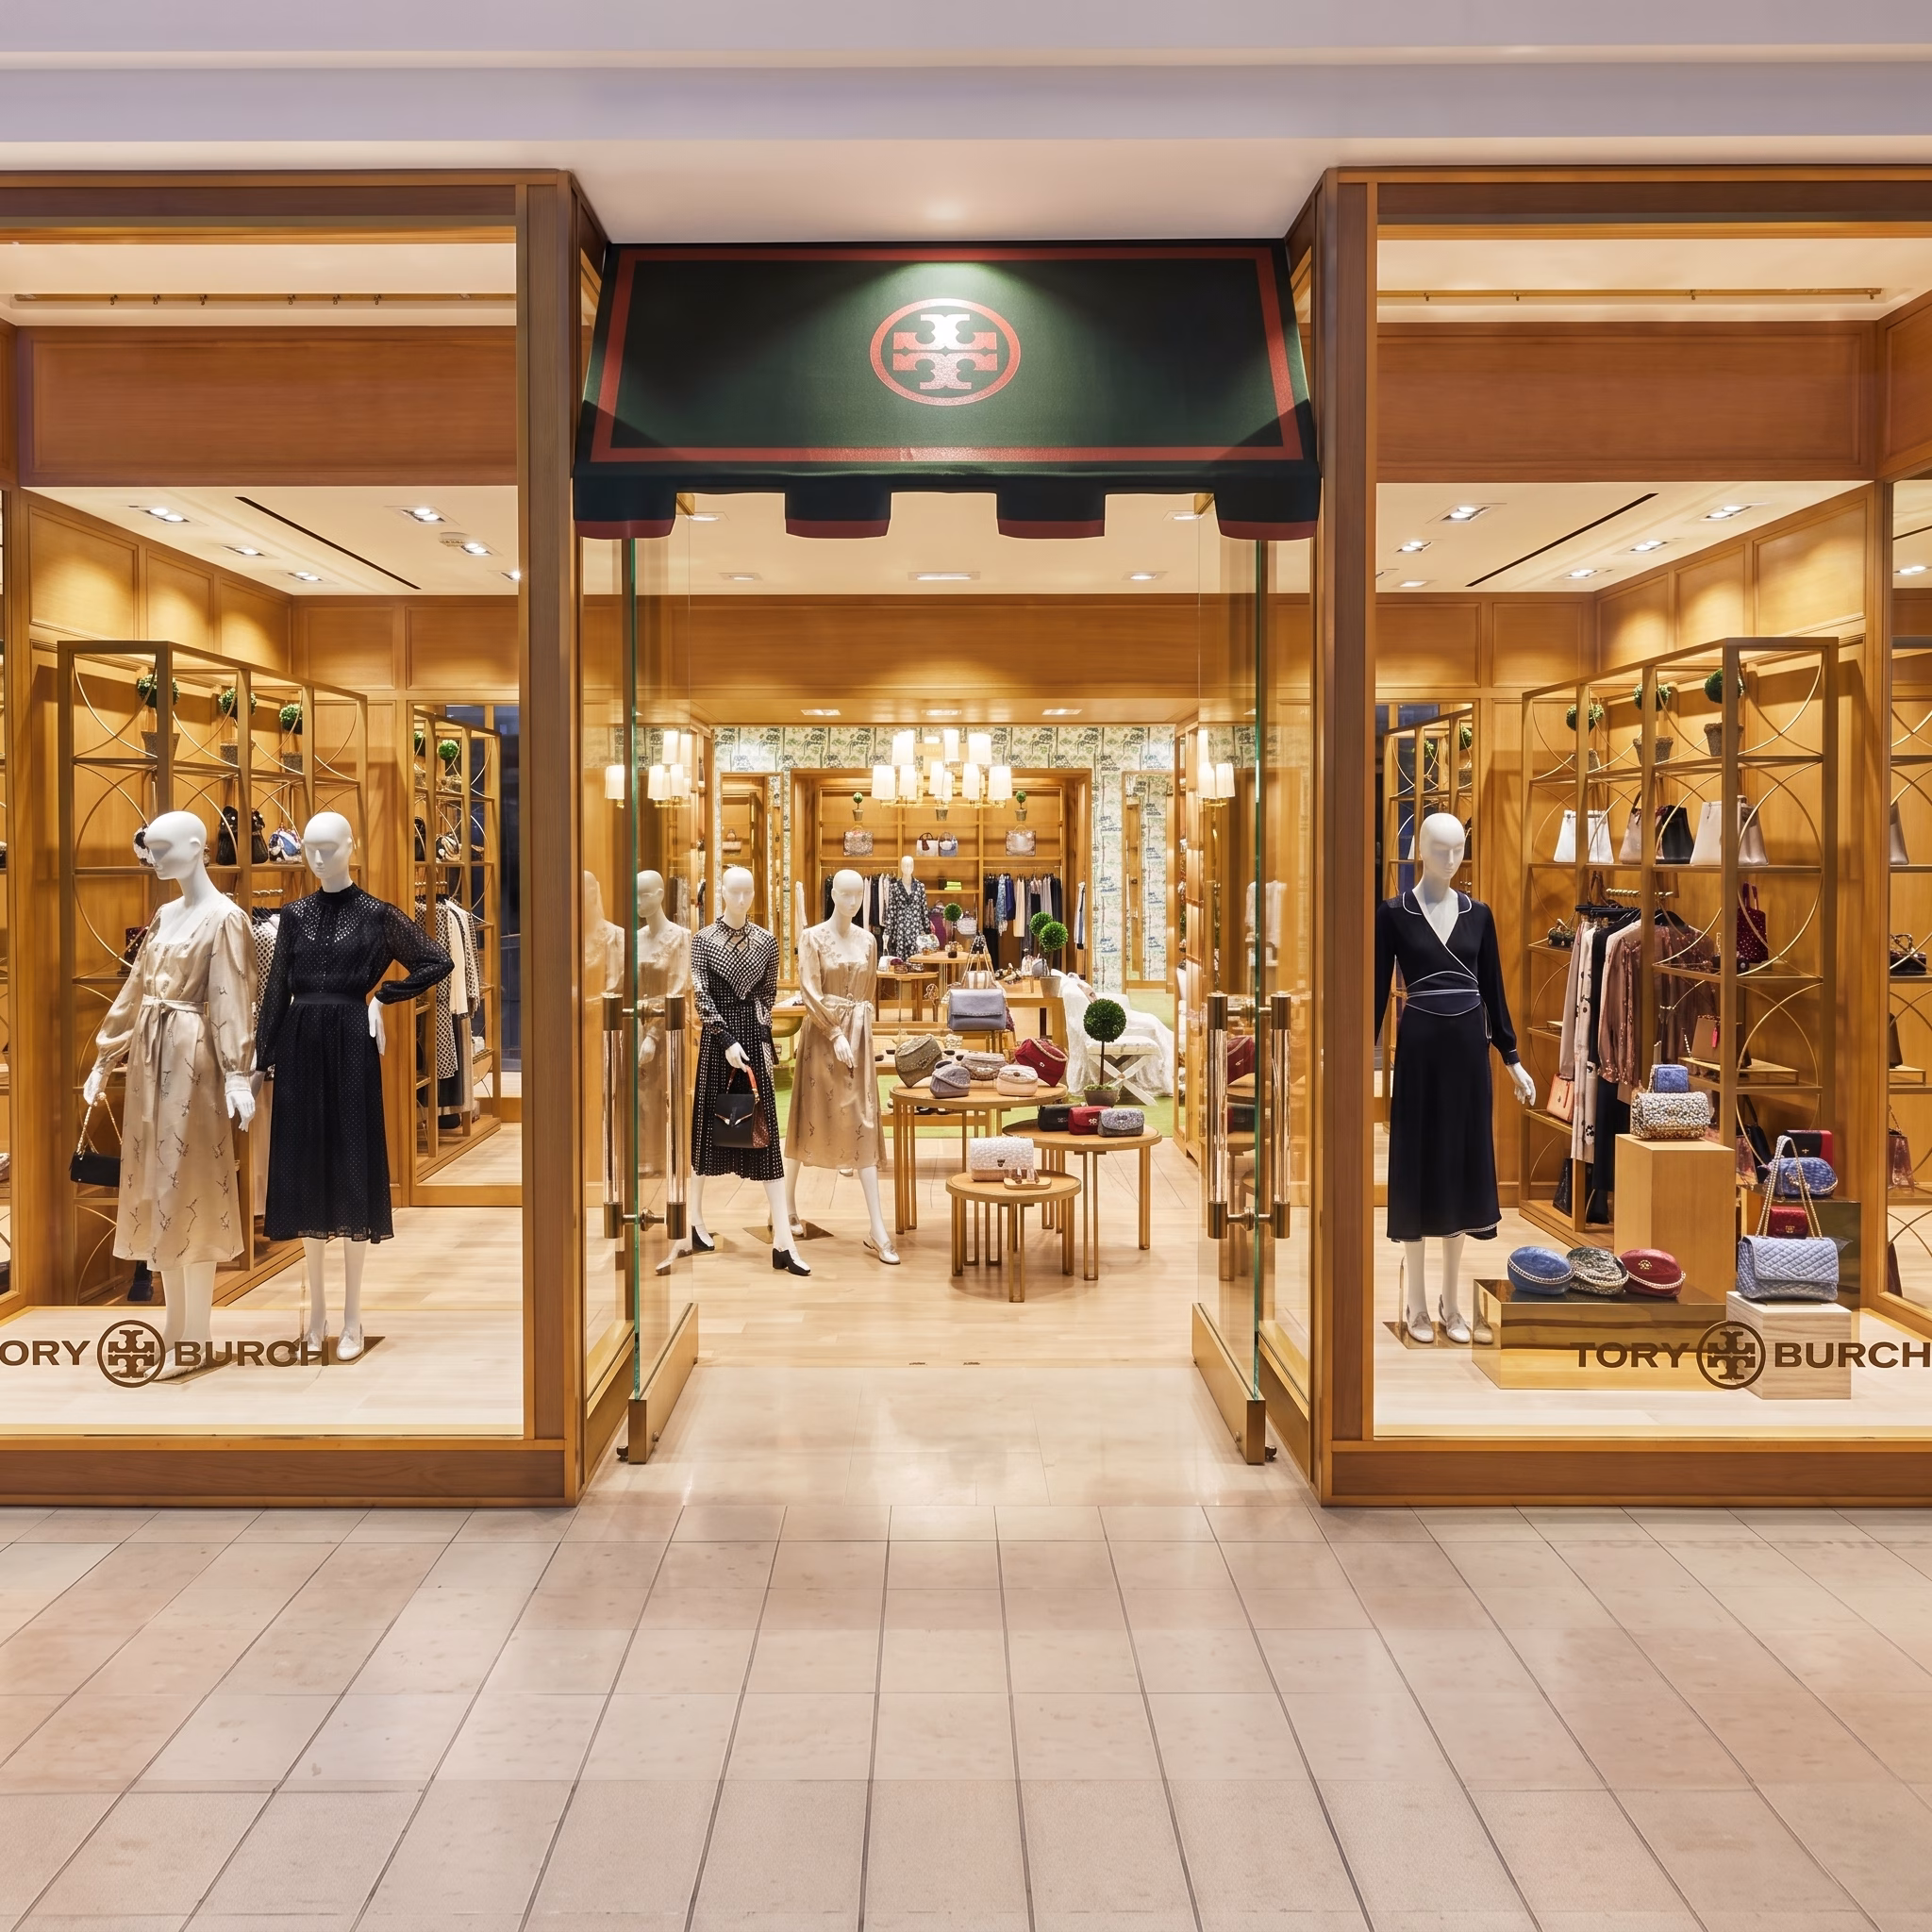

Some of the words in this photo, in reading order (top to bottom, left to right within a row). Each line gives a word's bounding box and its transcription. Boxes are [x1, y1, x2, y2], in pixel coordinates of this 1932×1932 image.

[0, 1340, 92, 1366] ORY
[175, 1341, 329, 1367] BURCH
[1570, 1341, 1690, 1368] TORY
[1774, 1341, 1930, 1368] BURCH
